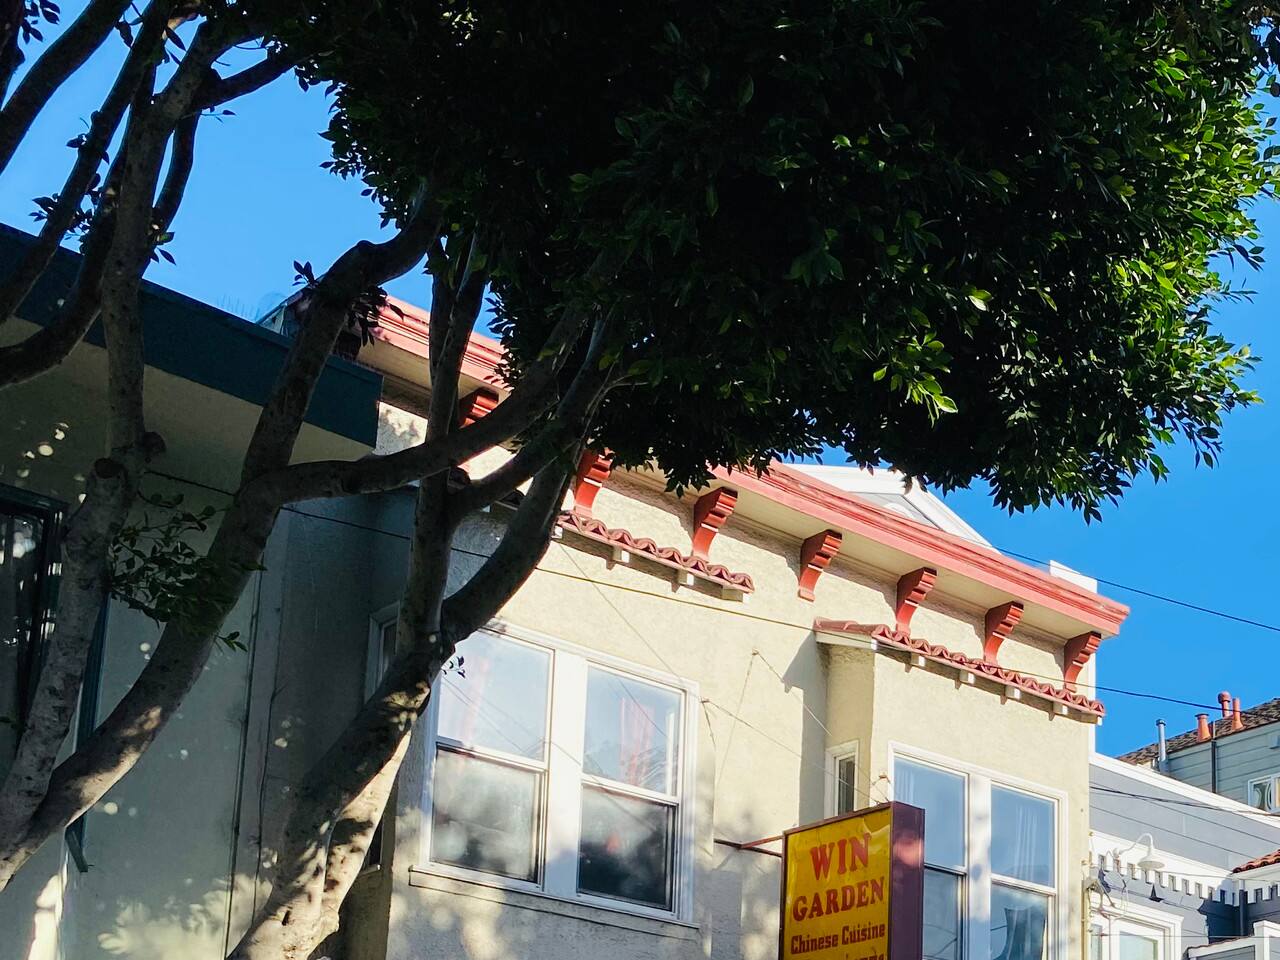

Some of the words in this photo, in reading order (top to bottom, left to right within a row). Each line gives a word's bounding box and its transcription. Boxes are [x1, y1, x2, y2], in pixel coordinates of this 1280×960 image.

[810, 833, 871, 880] WIN
[792, 876, 885, 922] GARDEN
[790, 934, 839, 955] Chinese
[841, 923, 886, 946] Cuisine
